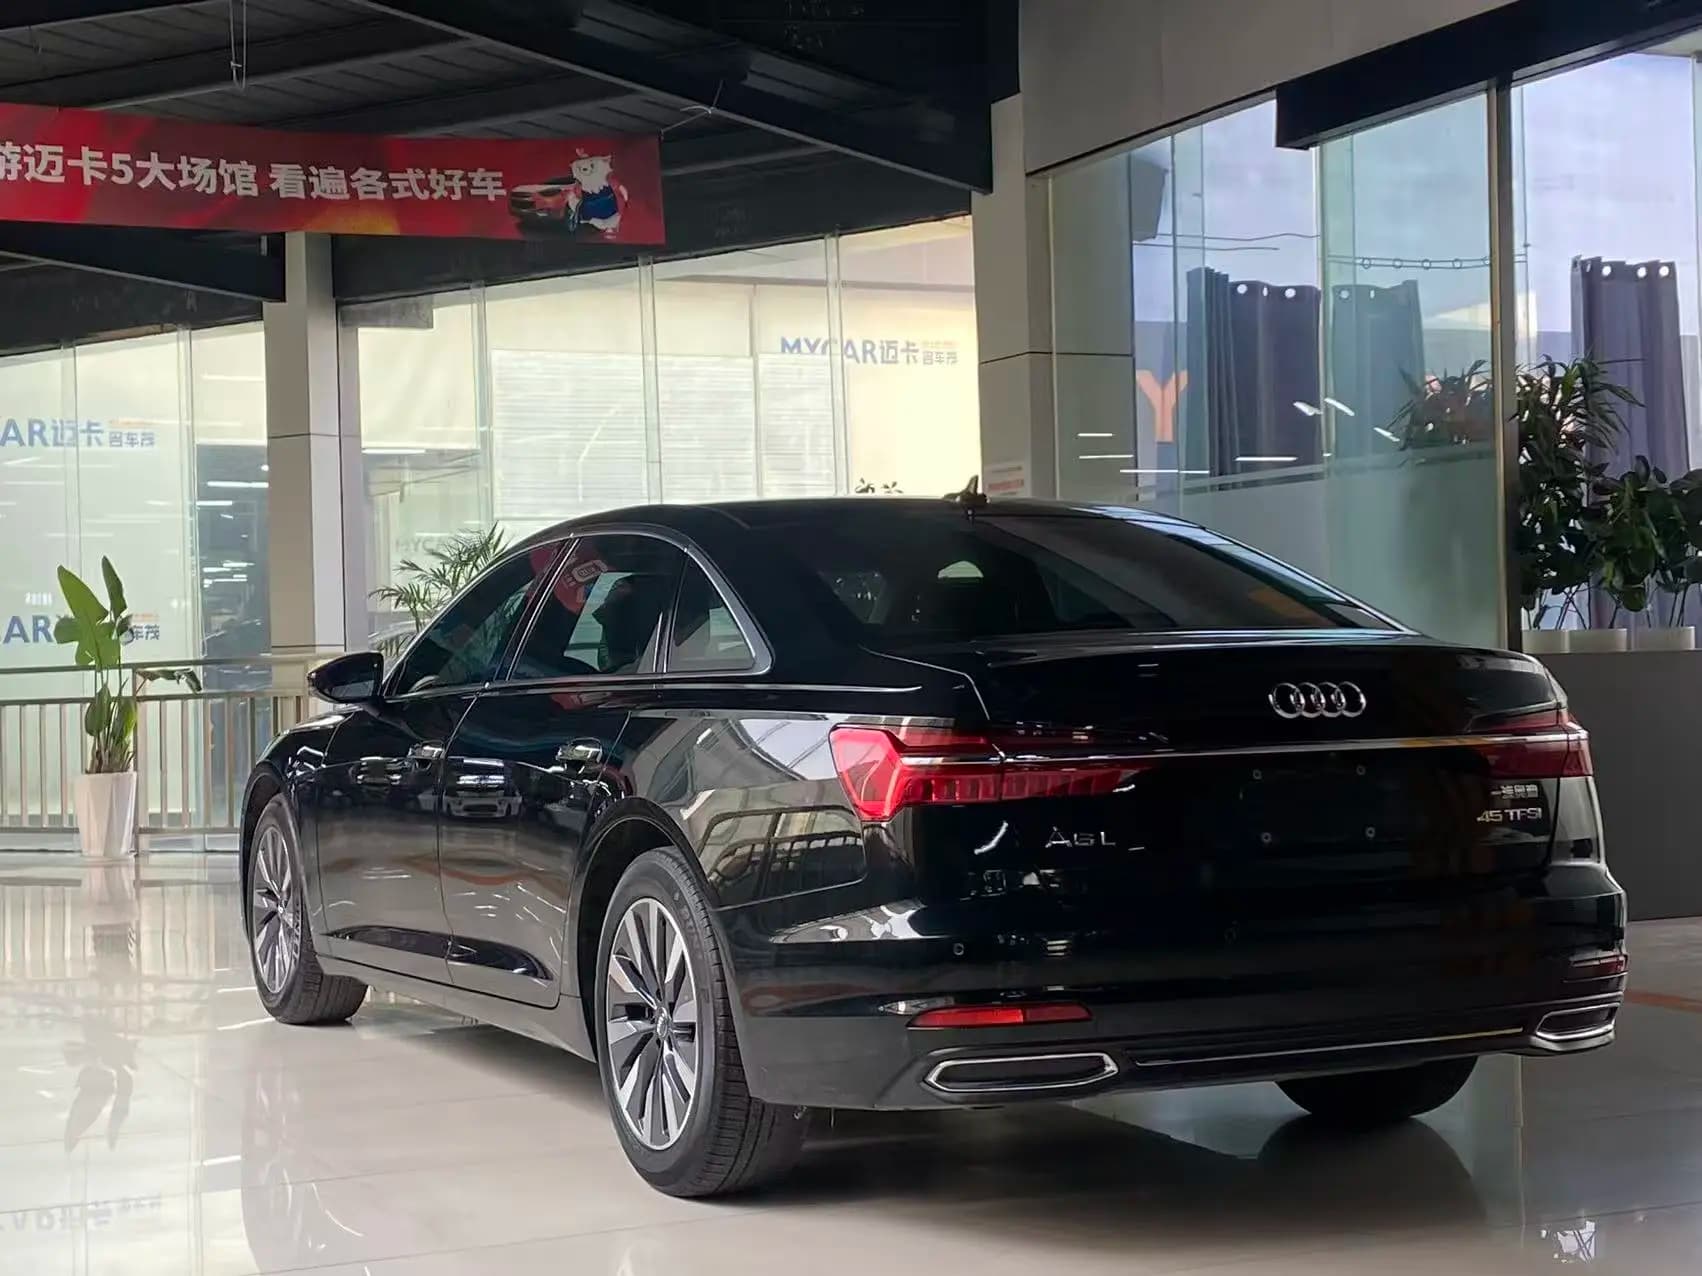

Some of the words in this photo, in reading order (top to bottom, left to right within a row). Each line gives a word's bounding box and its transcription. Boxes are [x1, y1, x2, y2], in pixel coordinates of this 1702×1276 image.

[269, 163, 507, 201] 看遍各式好车
[1477, 809, 1503, 823] 45
[1504, 807, 1542, 821] TFSI
